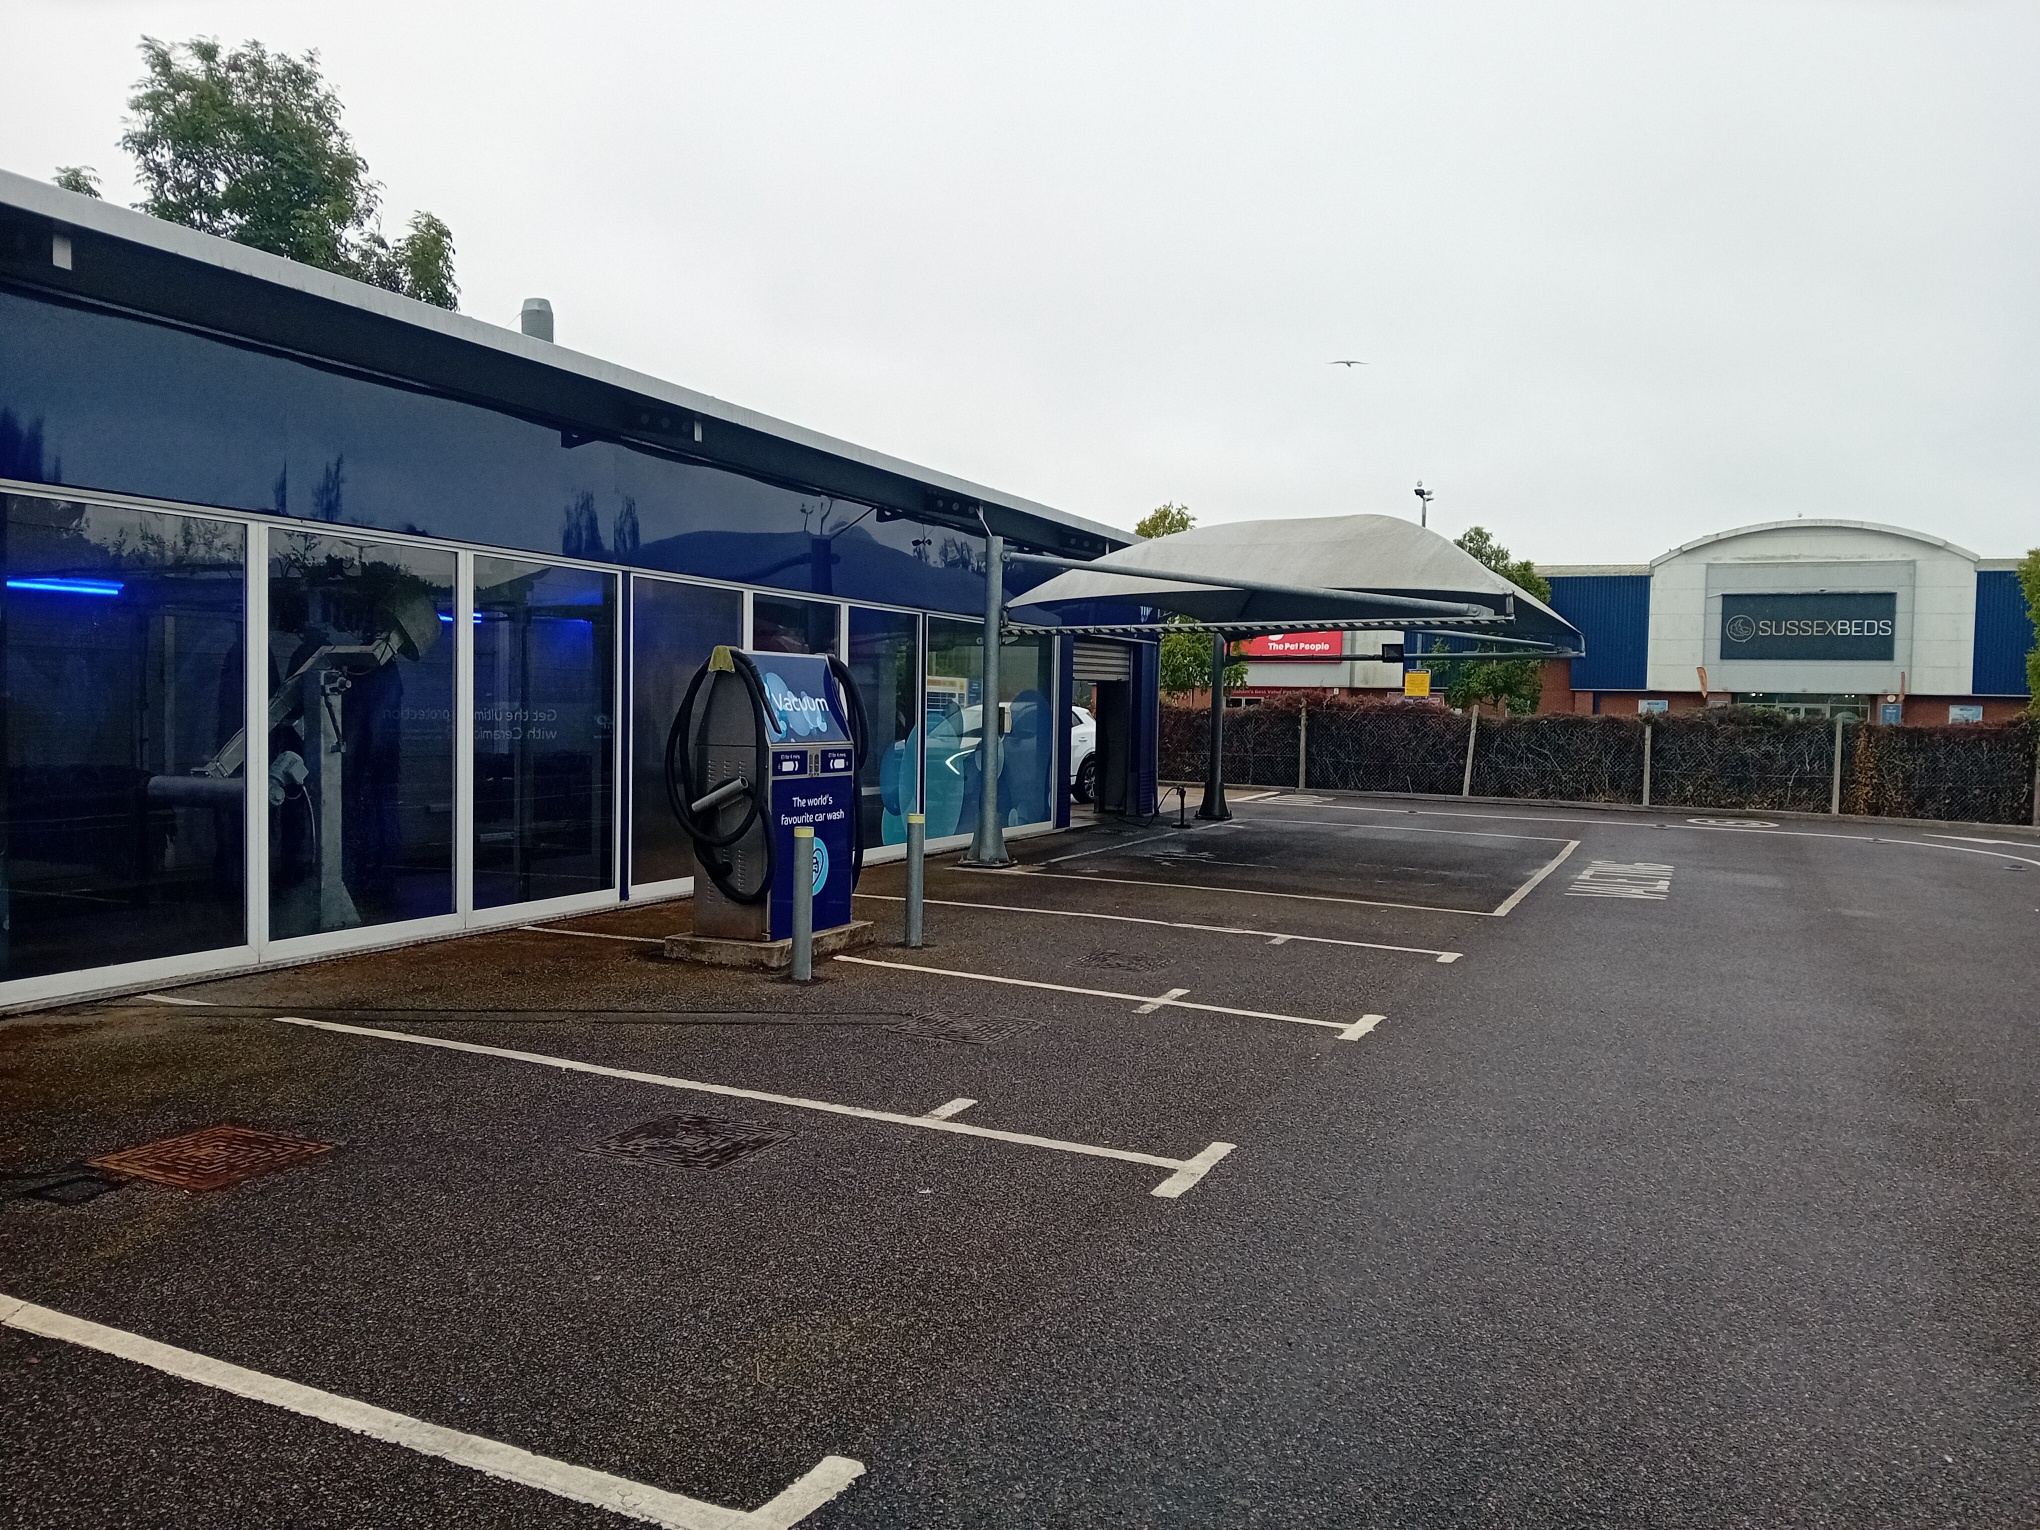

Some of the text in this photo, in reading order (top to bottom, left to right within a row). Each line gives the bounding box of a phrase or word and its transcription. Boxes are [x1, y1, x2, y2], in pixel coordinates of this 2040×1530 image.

[1759, 619, 1892, 636] SUSSEXBEDS
[1267, 641, 1330, 652] The Pet People
[771, 692, 829, 712] Vacuum
[792, 794, 833, 808] The world's
[781, 808, 845, 826] favourite car wash
